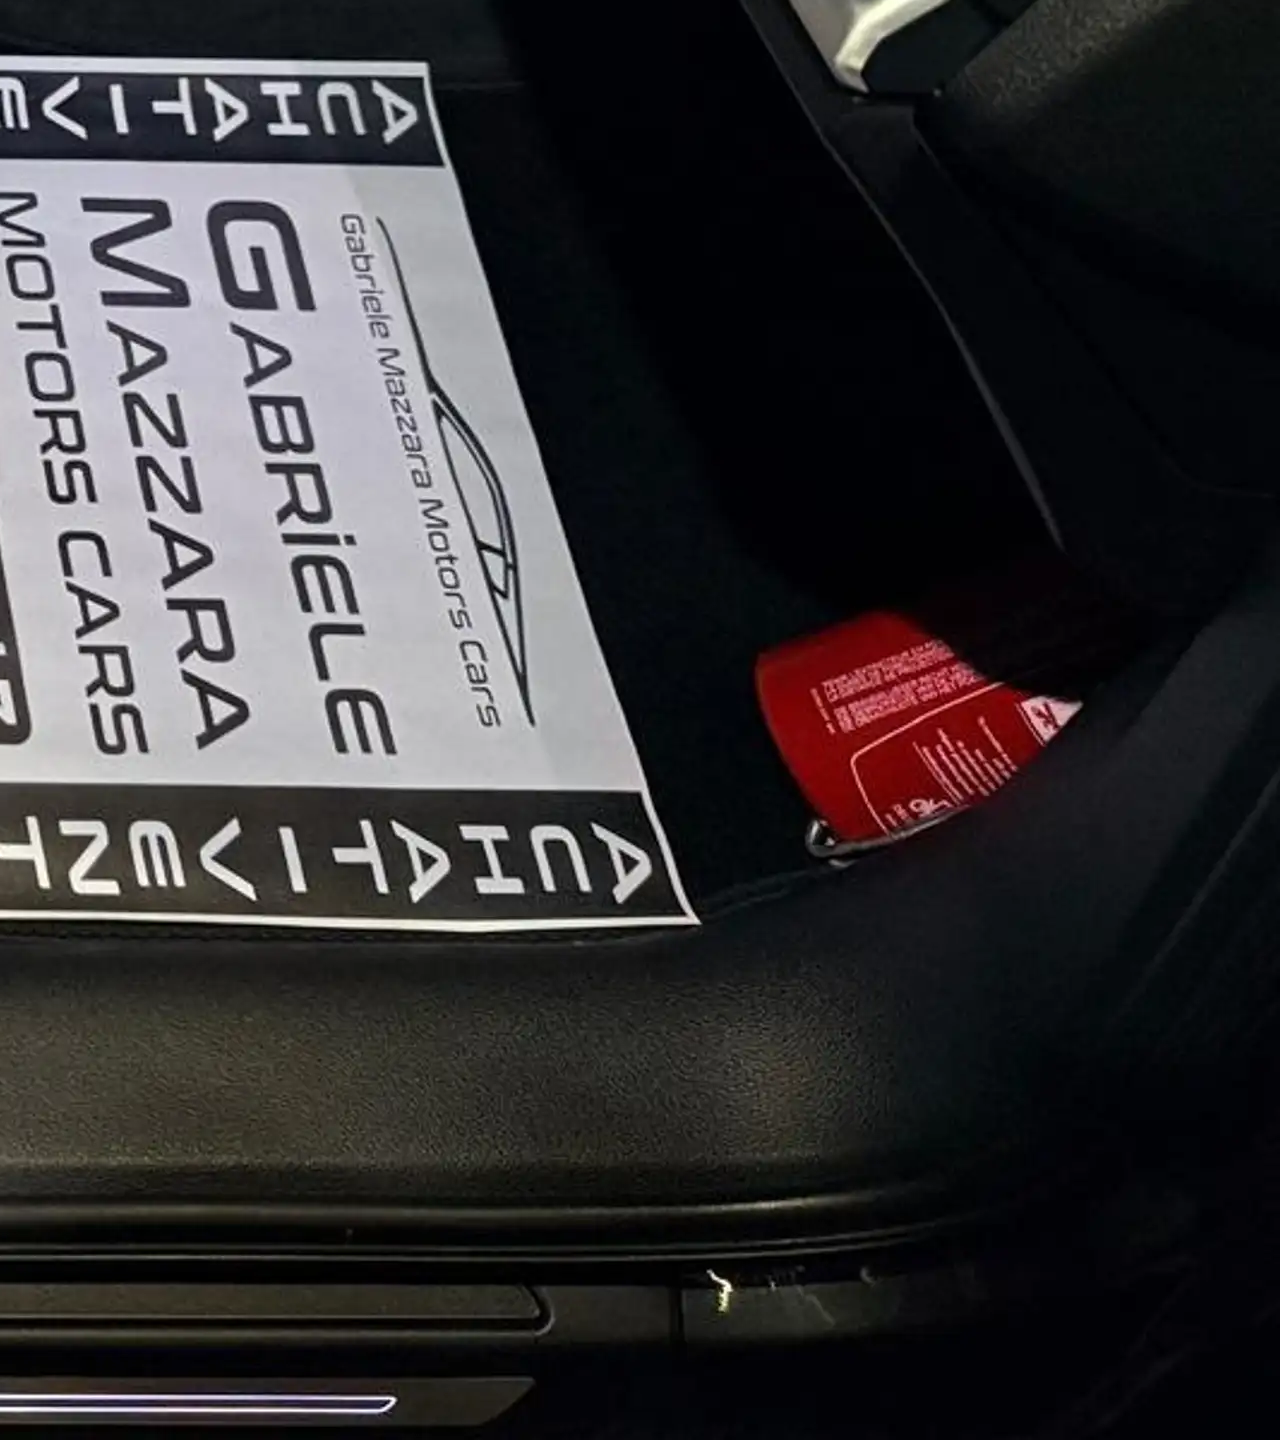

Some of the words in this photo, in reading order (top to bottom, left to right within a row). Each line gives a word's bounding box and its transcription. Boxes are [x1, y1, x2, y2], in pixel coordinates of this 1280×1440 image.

[59, 531, 149, 756] CARS
[80, 195, 250, 751] MAZZARA
[339, 213, 393, 338] Gabriele
[374, 347, 436, 488] Mazzara
[416, 498, 476, 630] Motors
[456, 640, 504, 727] Cars
